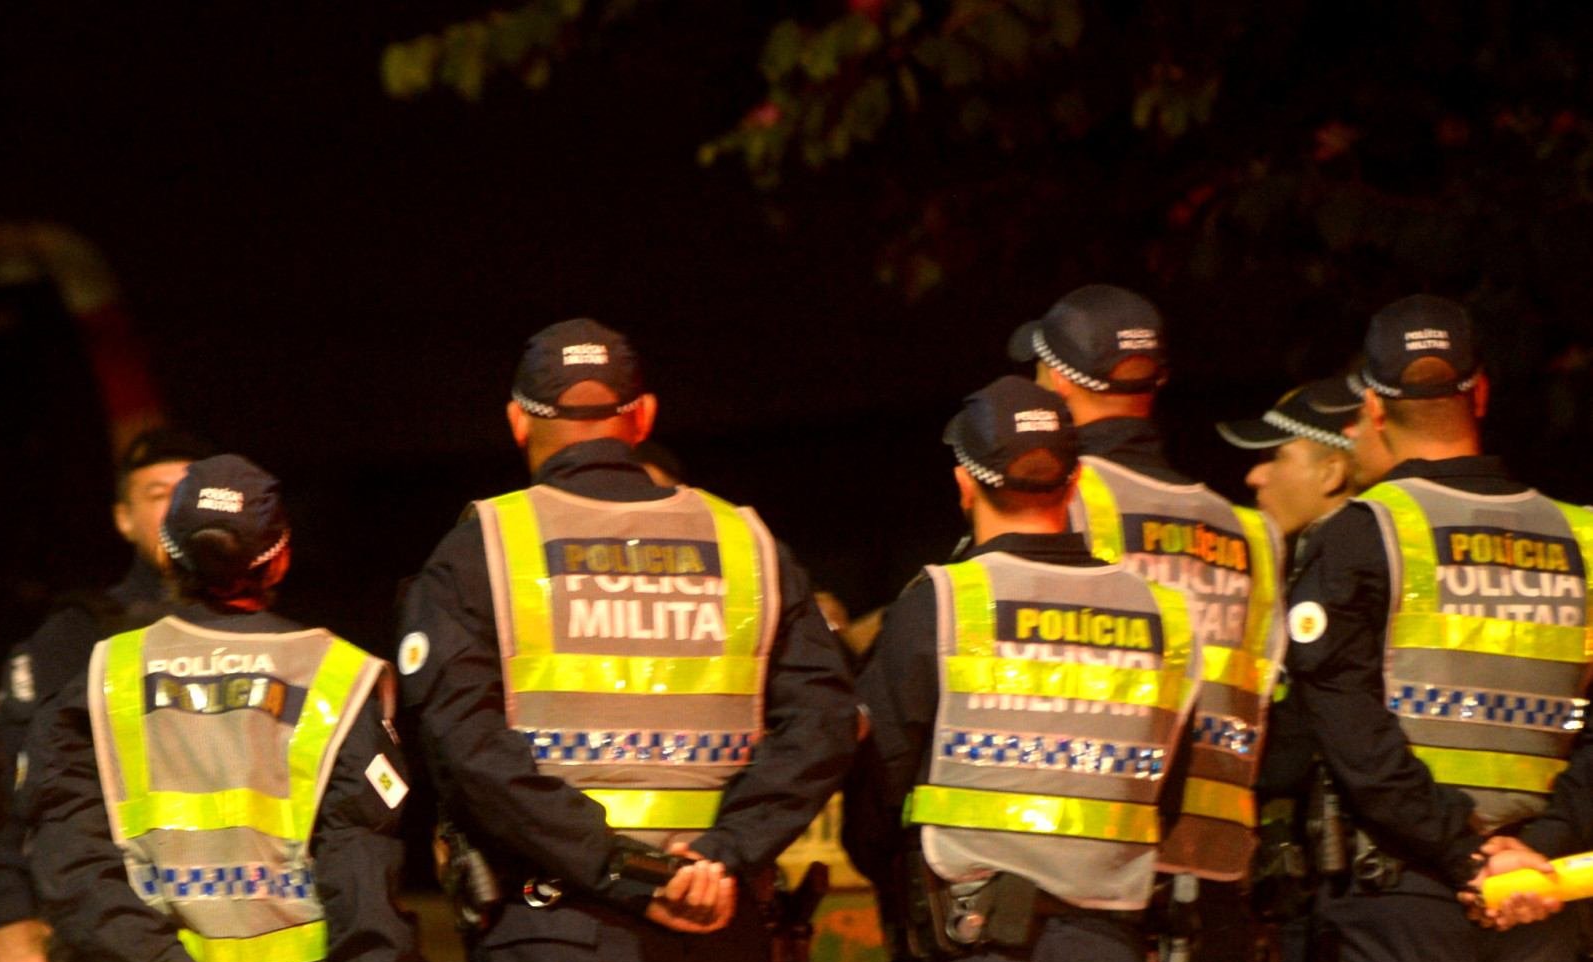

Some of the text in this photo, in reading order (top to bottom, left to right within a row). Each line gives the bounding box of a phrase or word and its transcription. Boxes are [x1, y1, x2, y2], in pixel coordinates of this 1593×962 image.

[563, 539, 706, 574] POLÍCIA
[1450, 530, 1571, 572] POLÍCIA
[1016, 606, 1154, 649] POLÍCIA
[147, 647, 277, 677] POLÍCIA
